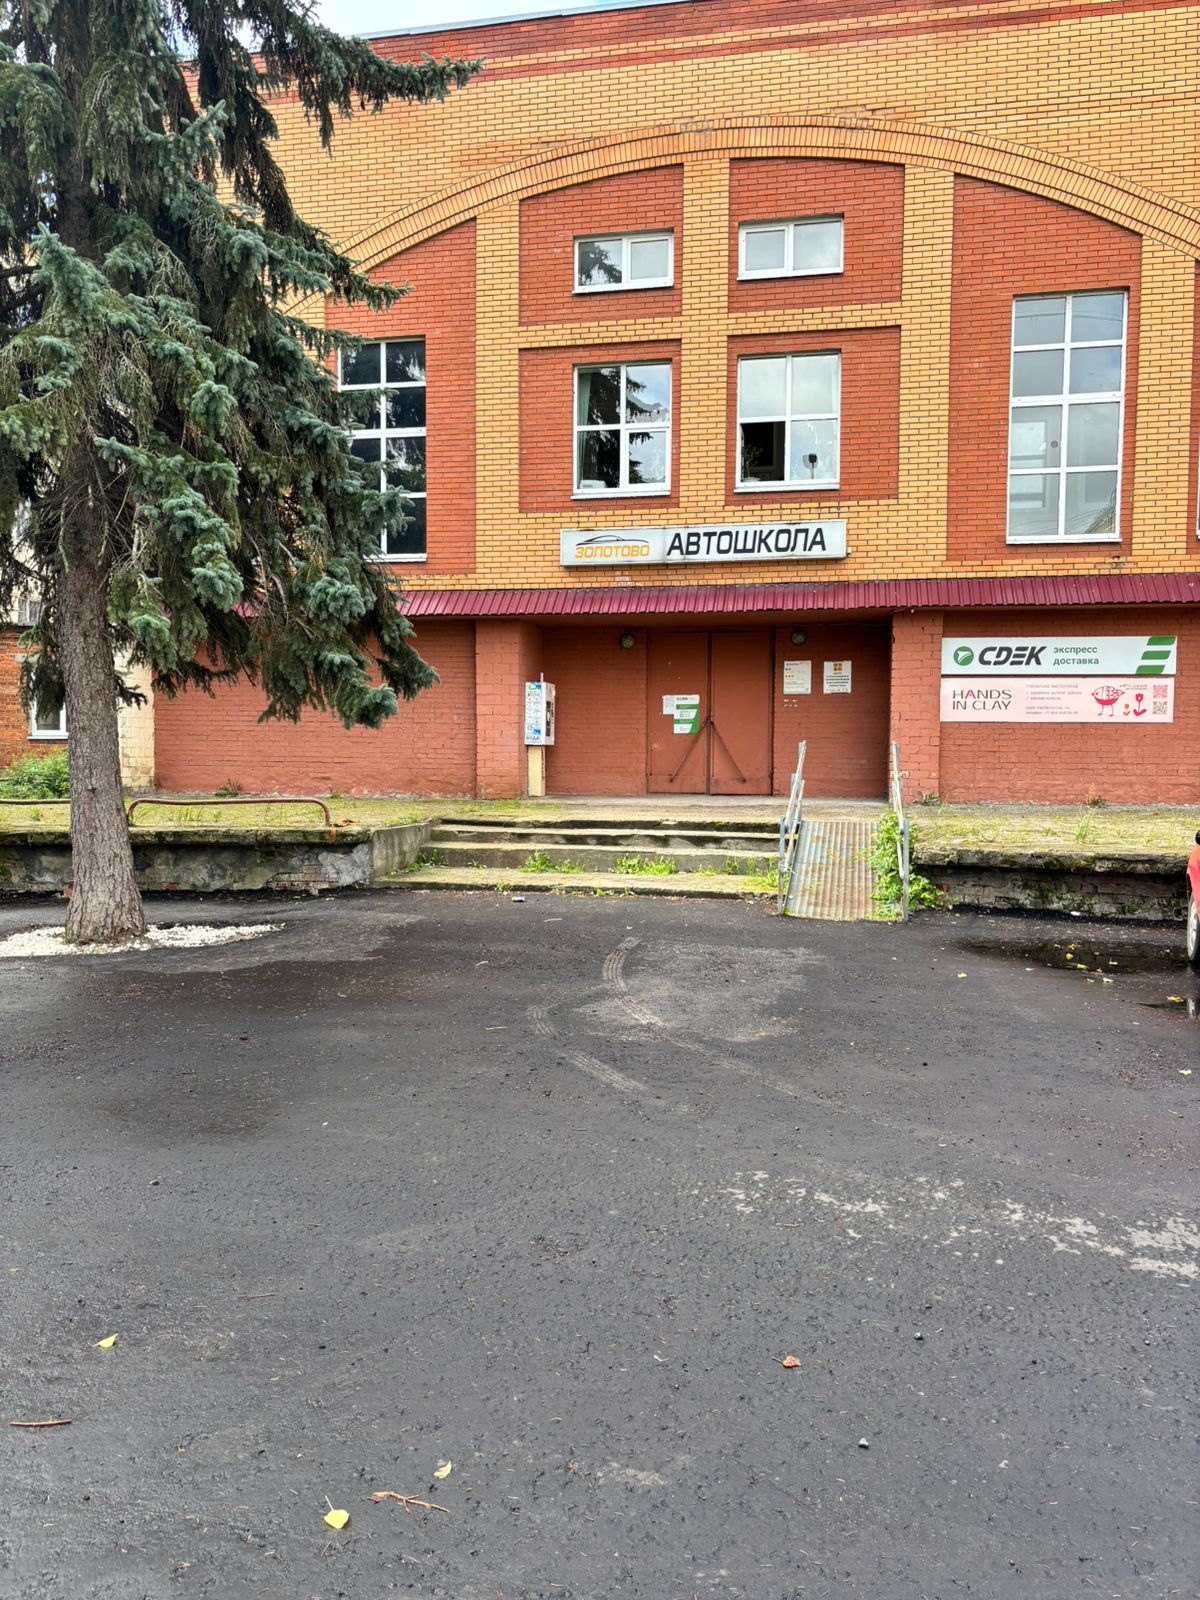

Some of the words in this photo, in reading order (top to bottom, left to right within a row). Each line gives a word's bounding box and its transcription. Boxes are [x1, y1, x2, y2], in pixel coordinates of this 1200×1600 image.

[666, 527, 827, 556] АВТОШКОЛА
[575, 545, 650, 559] ЗОЛОТОВО
[978, 646, 1048, 666] CDEK
[1053, 646, 1098, 655] экспресс
[1053, 657, 1100, 666] доставка
[952, 689, 1013, 699] HANDS
[952, 700, 967, 711] IN
[972, 700, 1012, 711] CLAY
